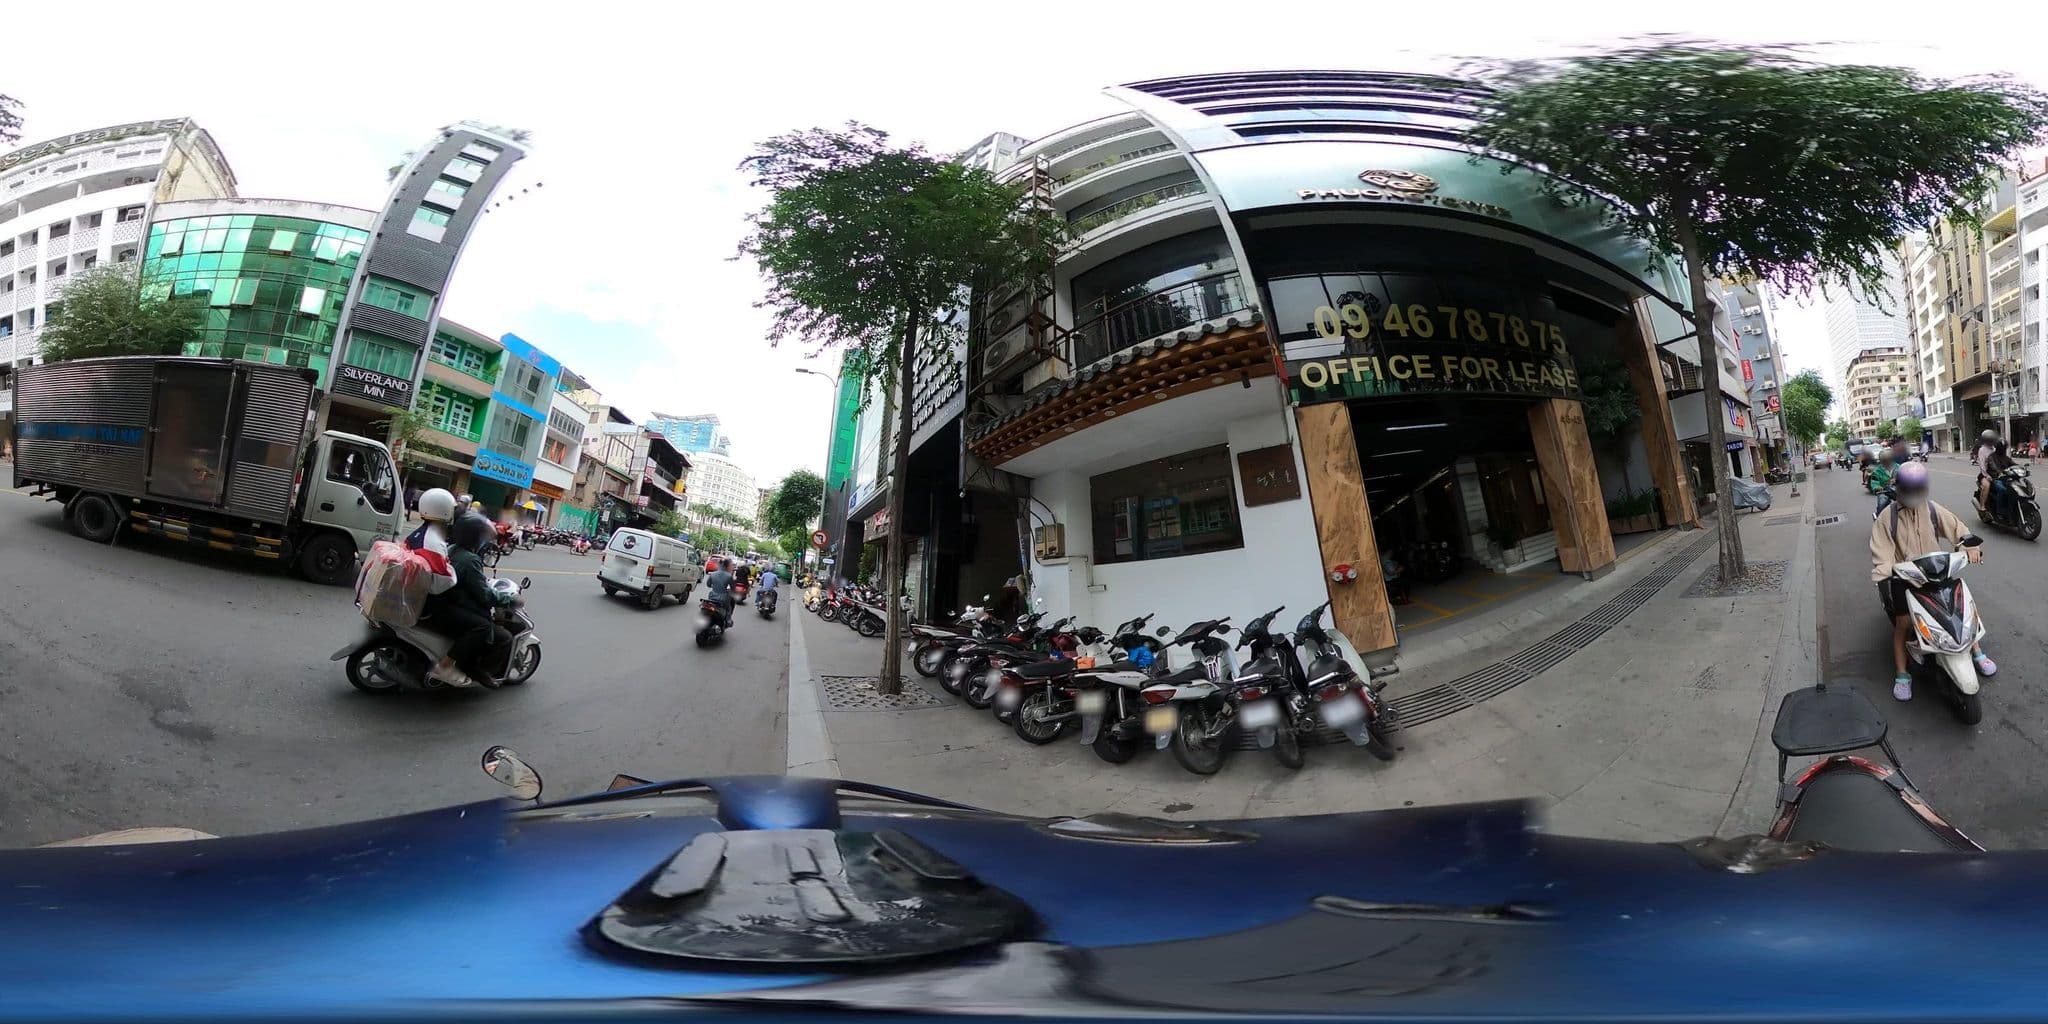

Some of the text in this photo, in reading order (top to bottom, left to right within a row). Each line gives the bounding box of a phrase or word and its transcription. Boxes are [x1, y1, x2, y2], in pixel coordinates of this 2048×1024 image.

[343, 367, 409, 392] SILVERLAND
[1300, 355, 1579, 389] OFFICE FOR LEASE
[363, 384, 386, 398] MIN
